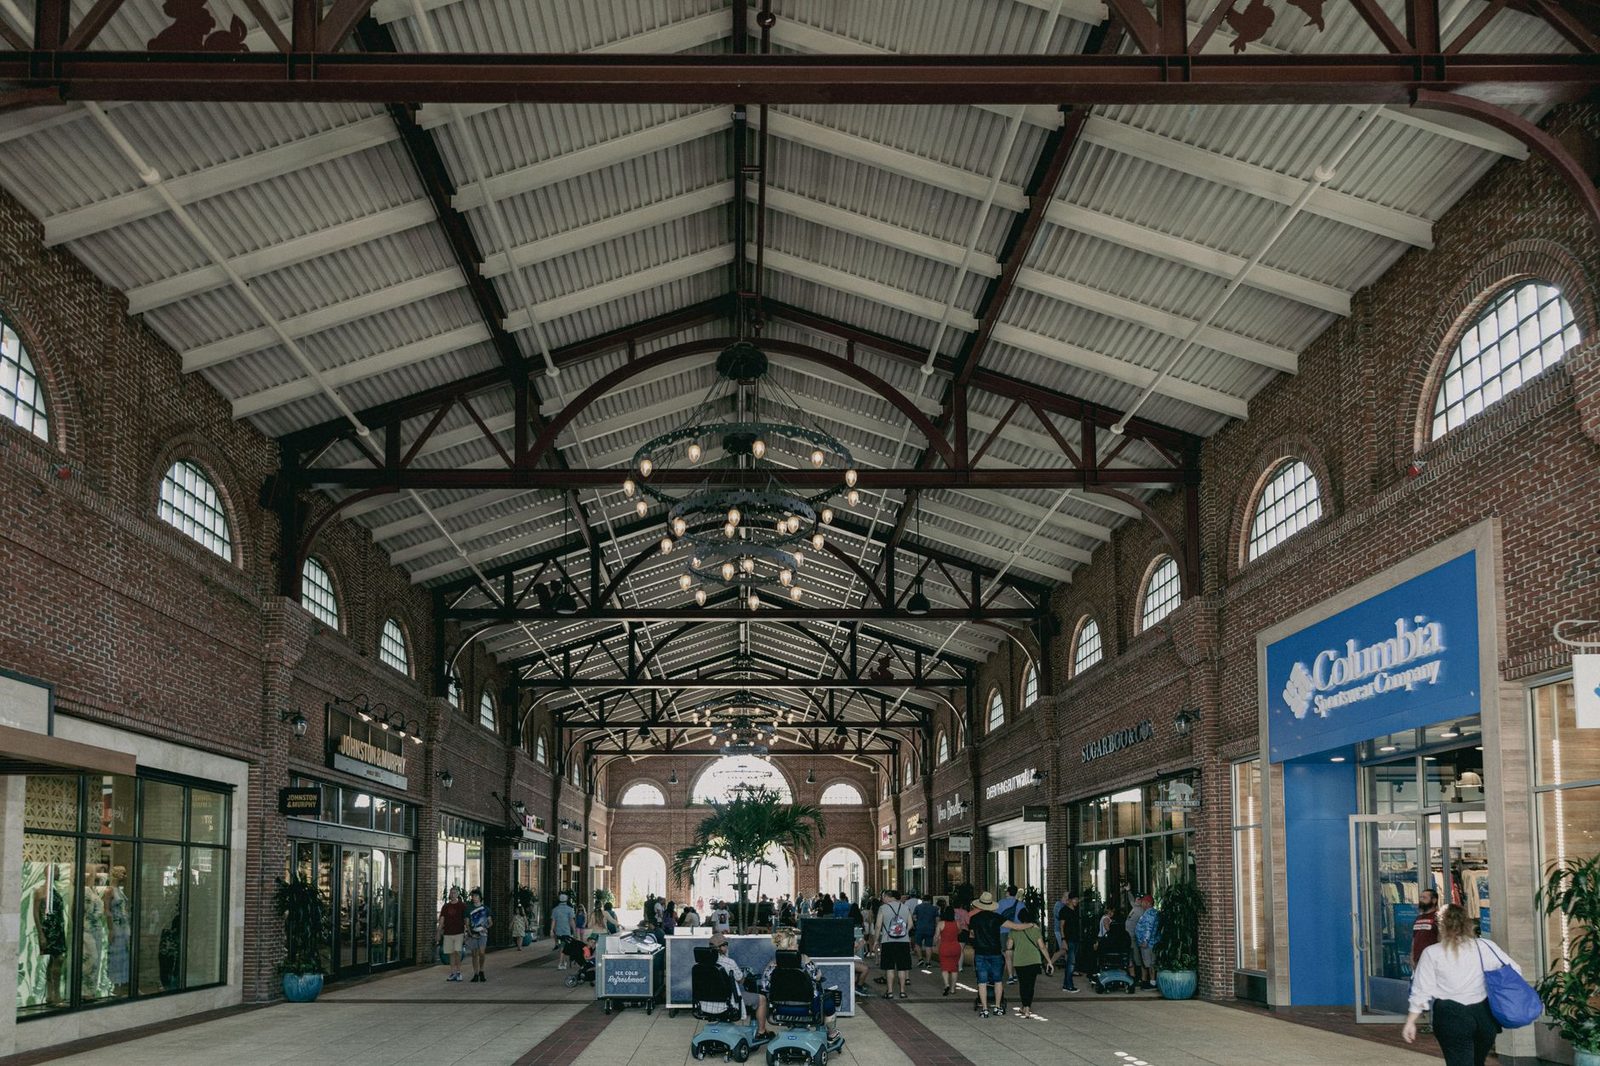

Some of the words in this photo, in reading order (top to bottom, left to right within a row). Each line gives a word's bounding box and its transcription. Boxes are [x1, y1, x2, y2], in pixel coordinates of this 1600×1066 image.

[1313, 615, 1446, 691] Columbia
[1314, 681, 1375, 718] Sportswear
[1374, 660, 1442, 692] Company
